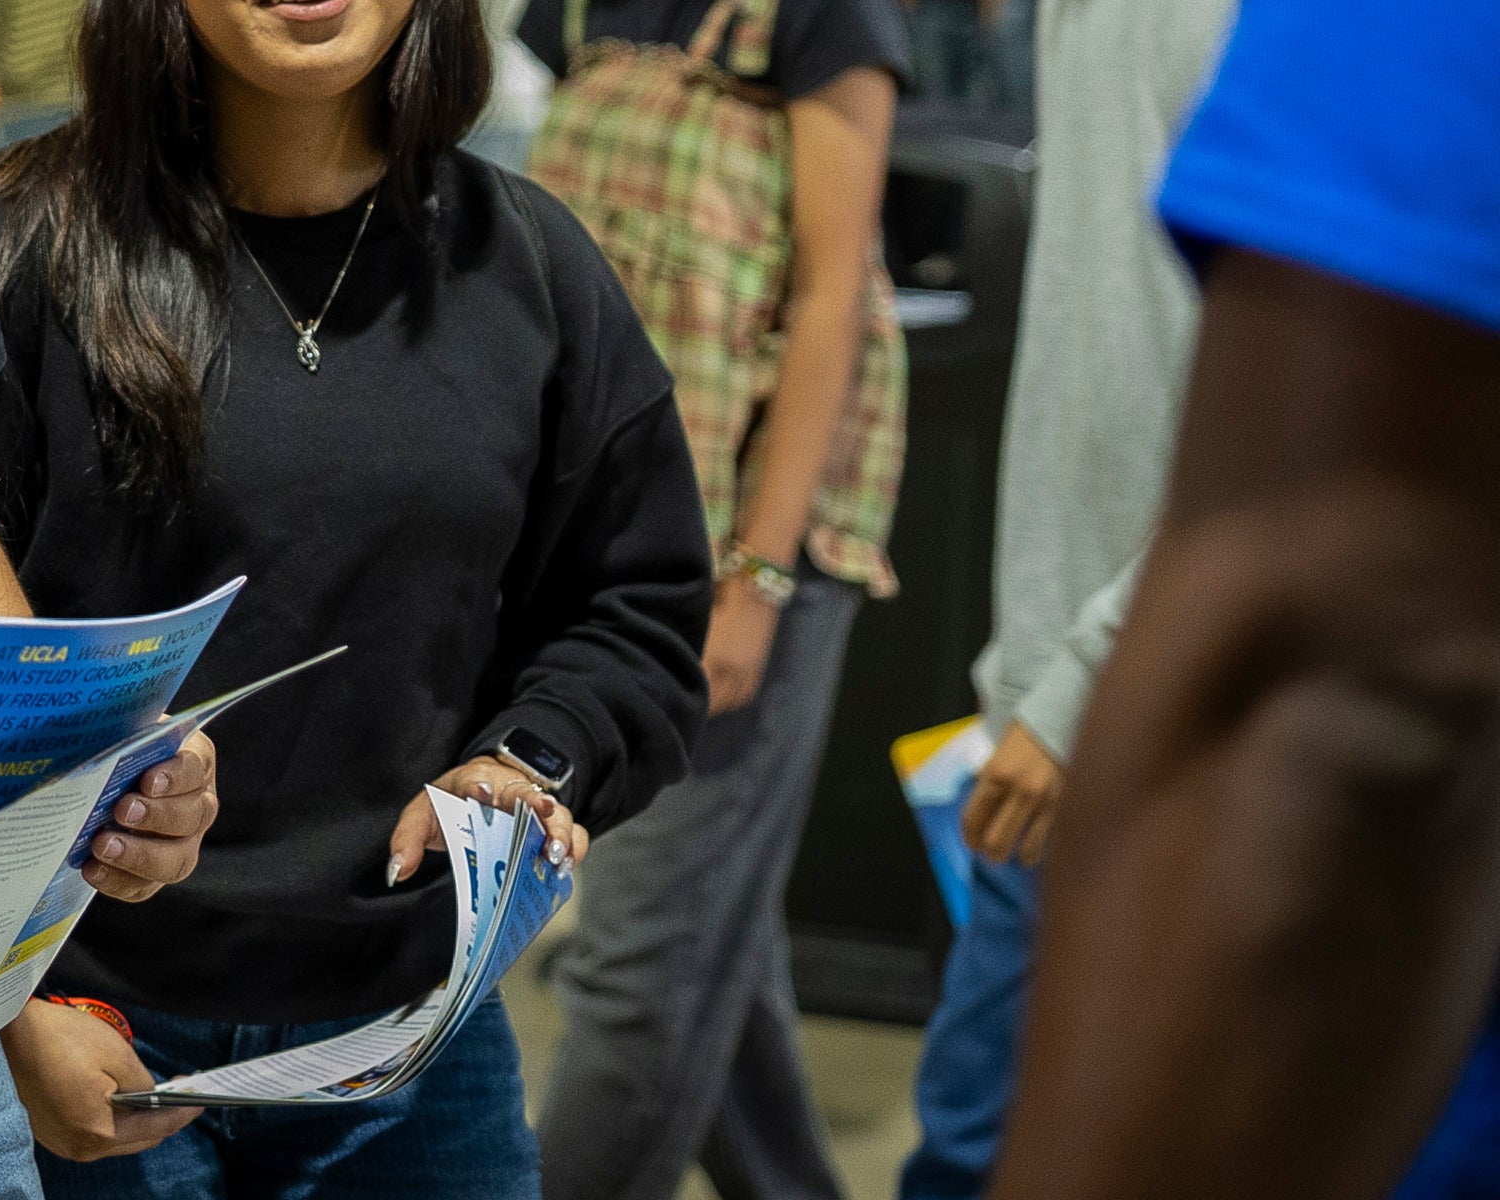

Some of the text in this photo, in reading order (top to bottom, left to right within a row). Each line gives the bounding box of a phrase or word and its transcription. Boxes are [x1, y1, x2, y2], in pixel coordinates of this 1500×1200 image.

[78, 642, 129, 661] WHAT
[128, 636, 163, 655] WILL
[24, 668, 84, 685] STUDY
[147, 645, 188, 670] MAKE
[88, 681, 138, 704] CHEER
[16, 714, 43, 730] AT
[3, 739, 20, 753] A
[20, 733, 83, 753] DEEPER
